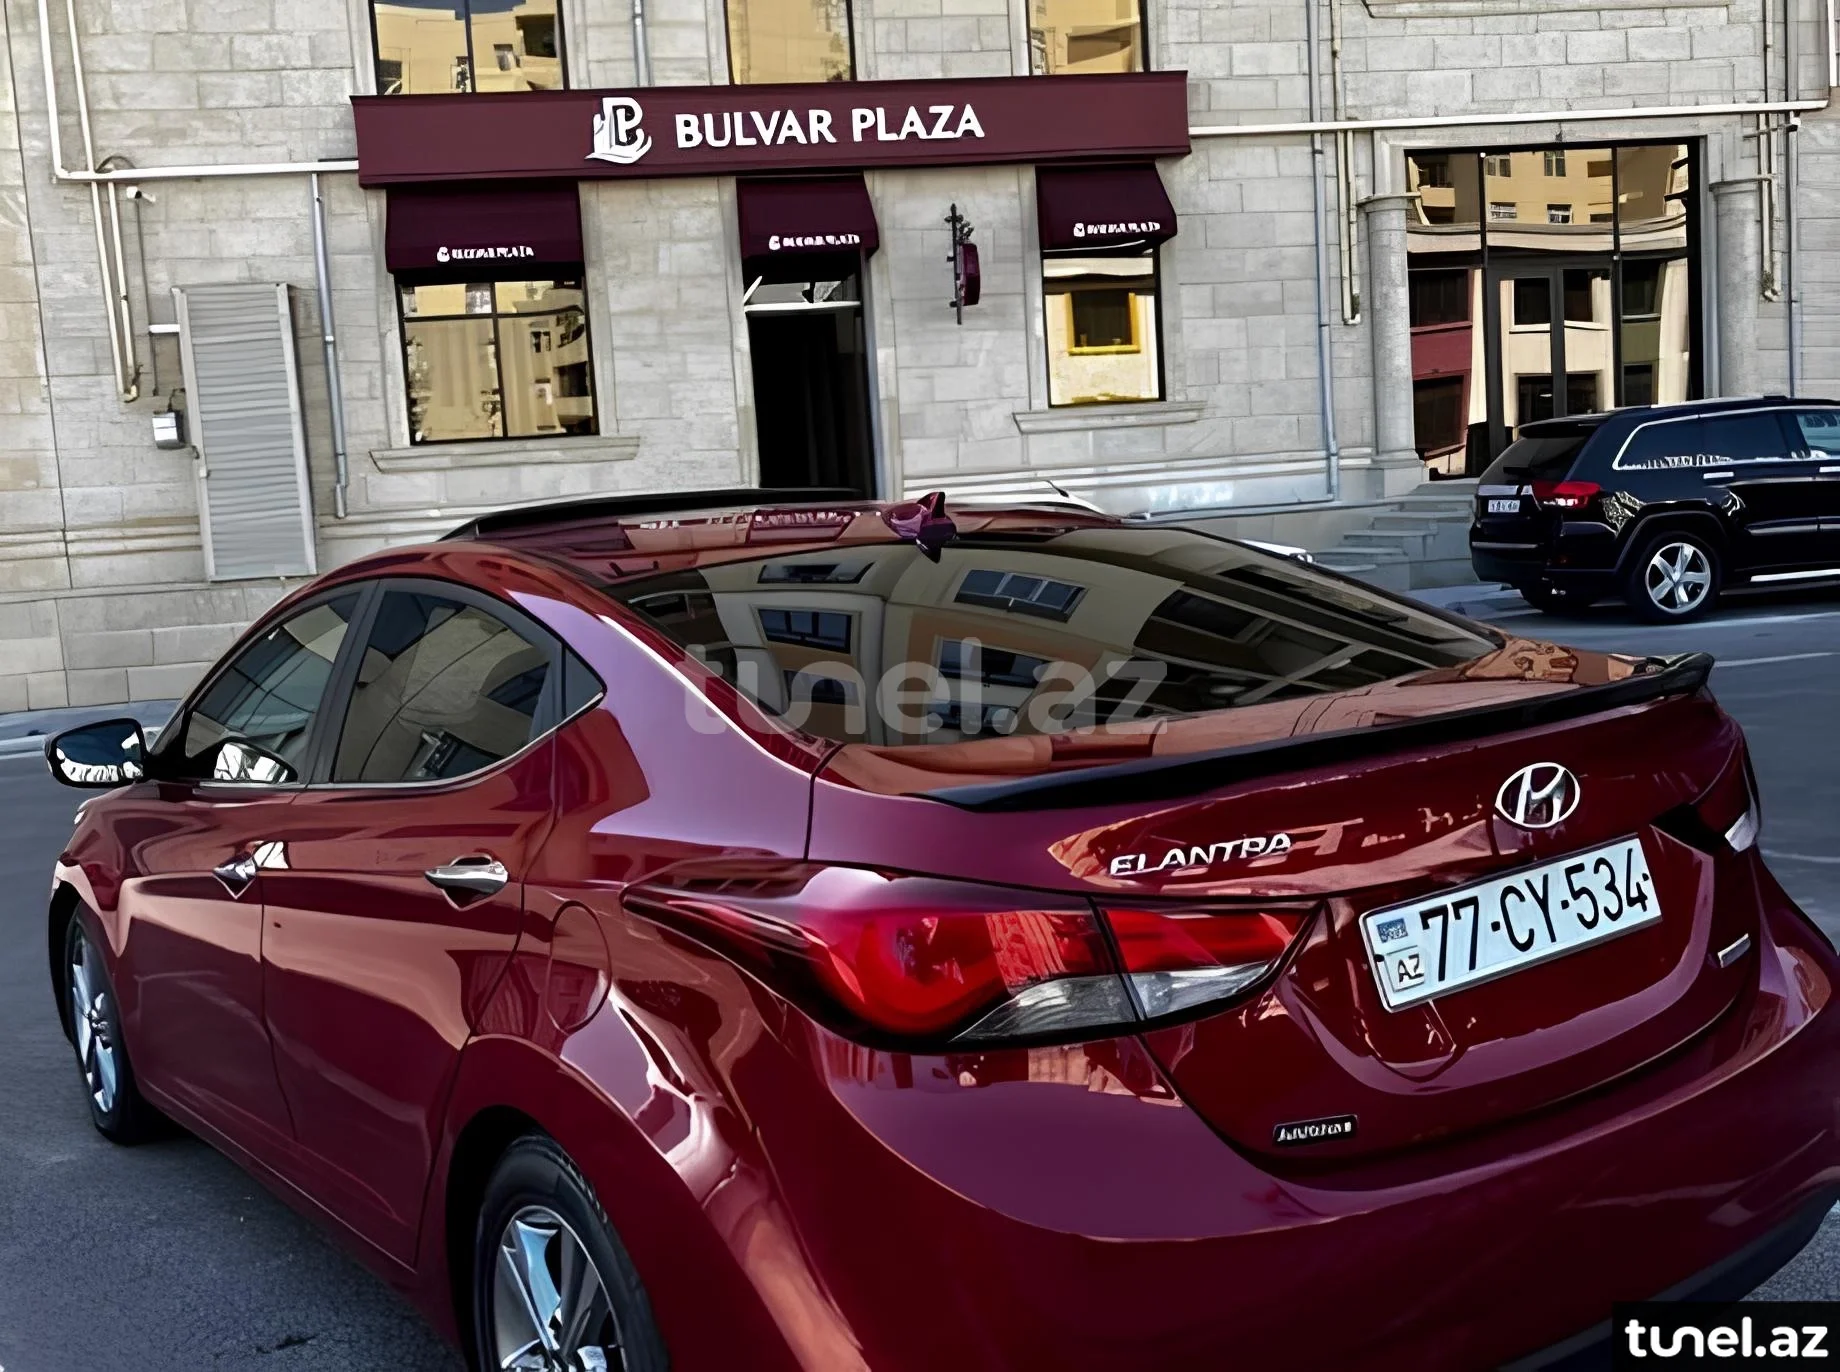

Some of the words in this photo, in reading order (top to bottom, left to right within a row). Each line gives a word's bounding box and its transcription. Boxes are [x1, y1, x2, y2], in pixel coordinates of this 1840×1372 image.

[675, 108, 836, 149] BULVAR
[851, 103, 985, 143] PLAZA
[1110, 833, 1292, 876] ELANTRA
[1397, 954, 1425, 983] AZ
